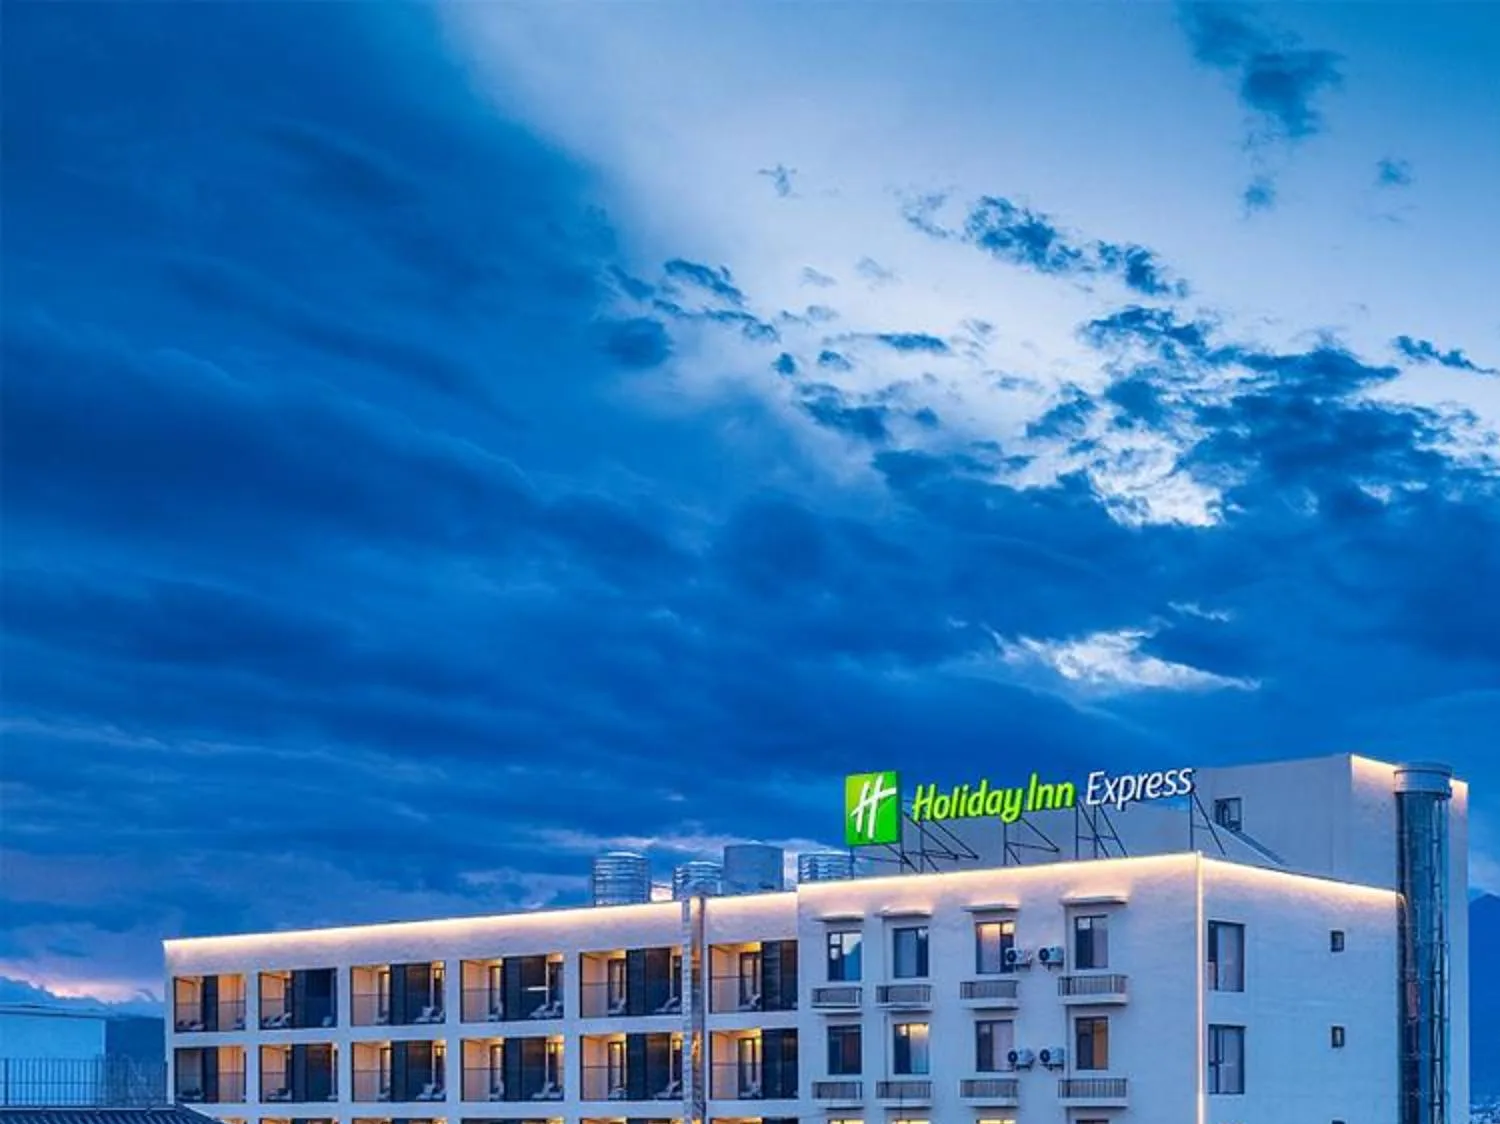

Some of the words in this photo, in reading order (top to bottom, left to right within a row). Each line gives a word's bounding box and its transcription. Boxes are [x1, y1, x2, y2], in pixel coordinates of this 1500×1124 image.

[913, 779, 1022, 823] Holiday
[1027, 772, 1074, 811] Inn
[1086, 767, 1194, 811] Express
